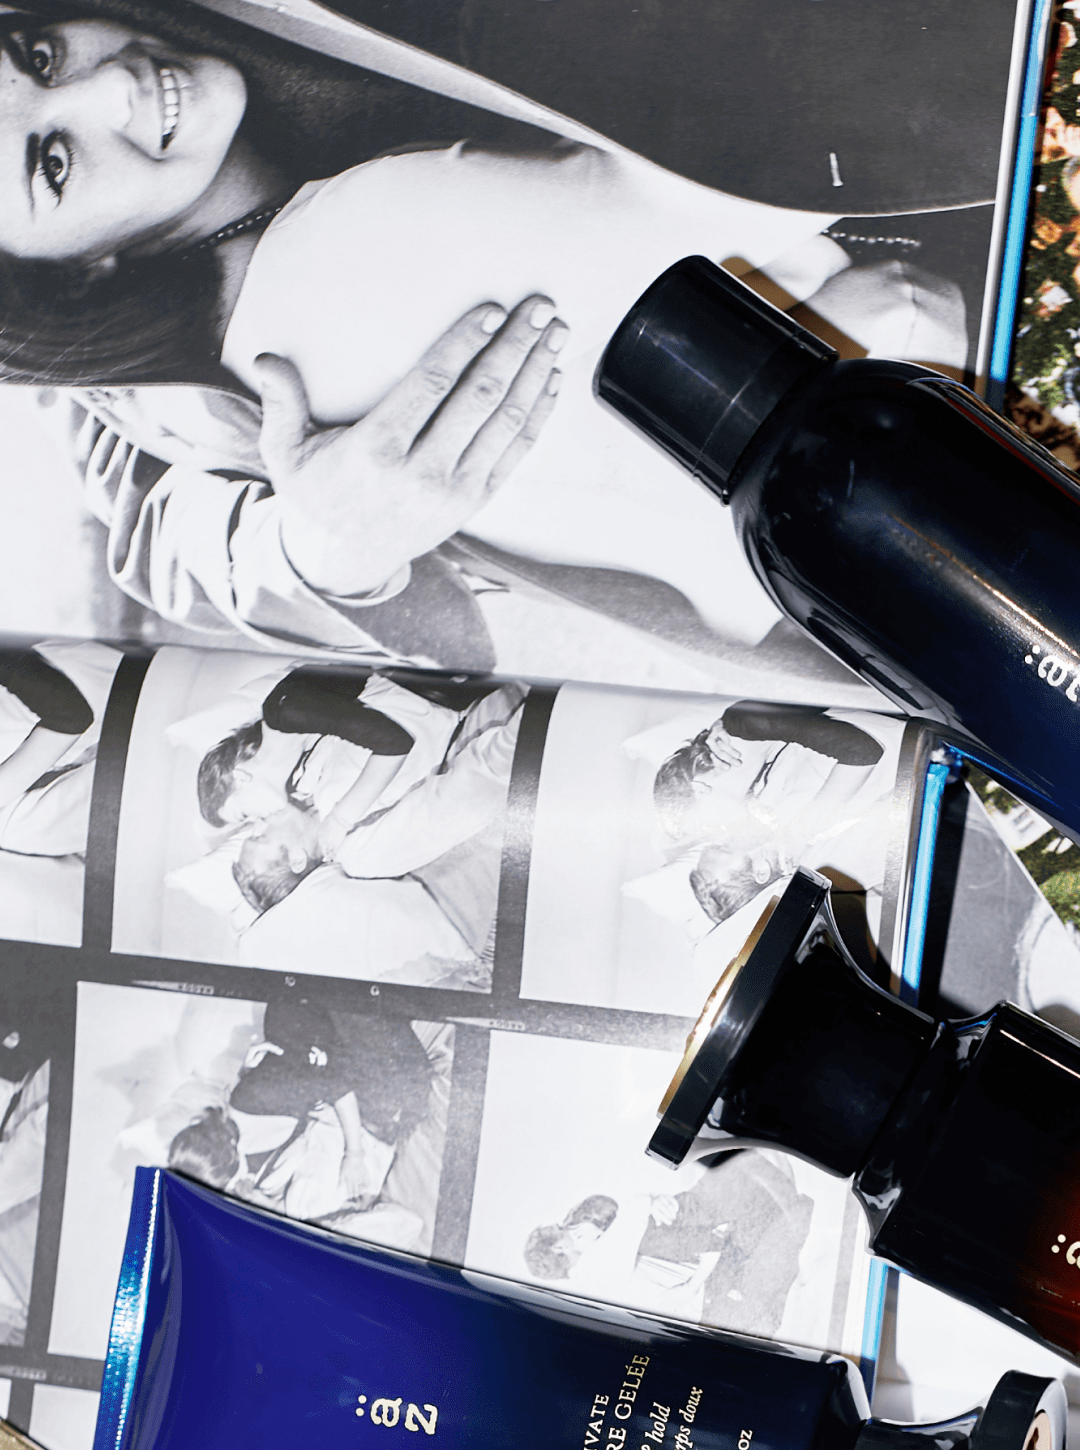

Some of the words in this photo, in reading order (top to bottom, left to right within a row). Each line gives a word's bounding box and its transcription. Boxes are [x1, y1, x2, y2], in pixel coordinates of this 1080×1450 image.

[615, 1355, 649, 1419] GELÉE
[679, 1387, 702, 1422] doux
[645, 1402, 670, 1443] hold
